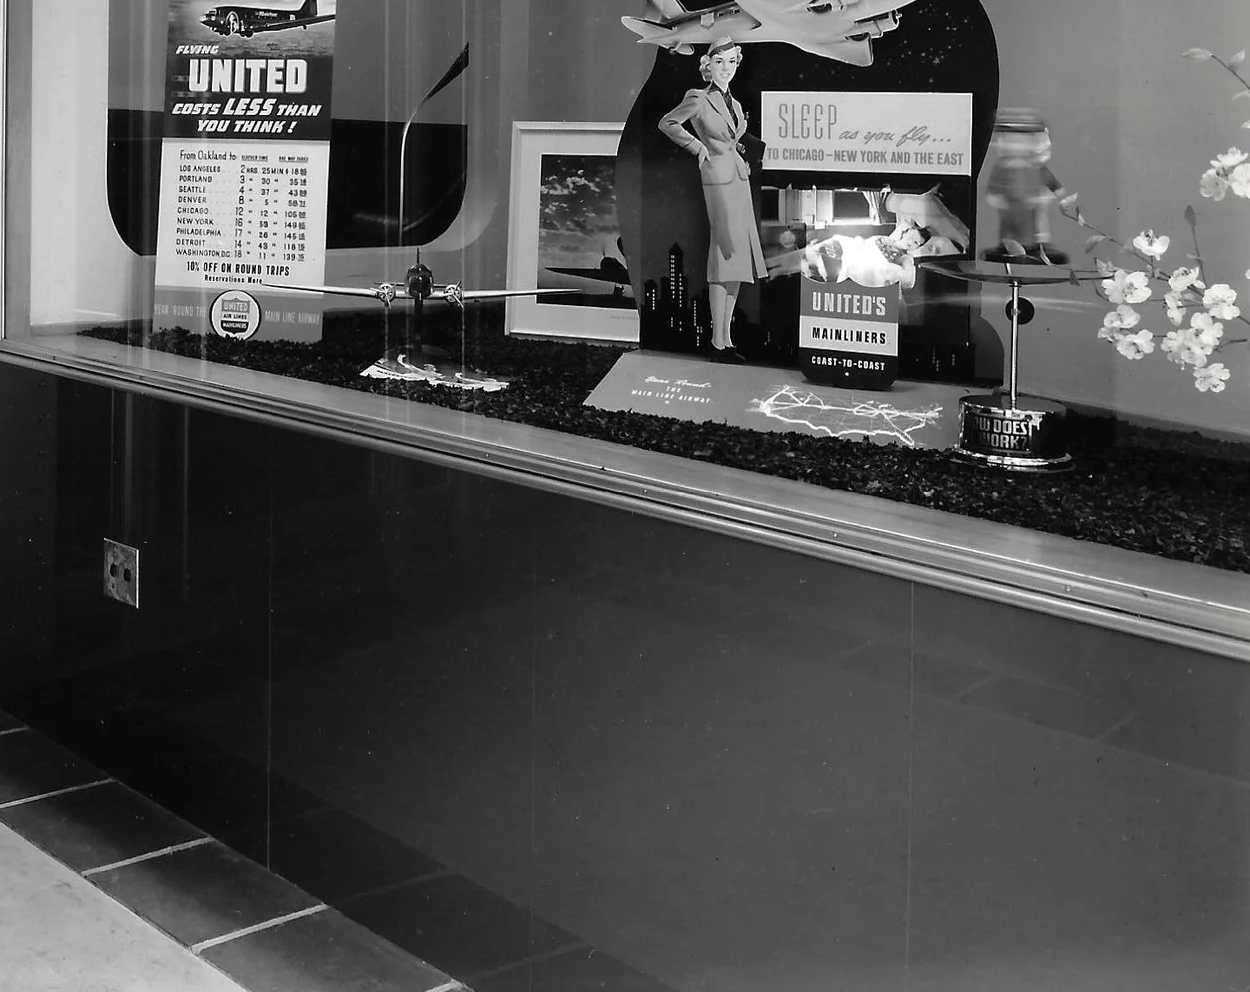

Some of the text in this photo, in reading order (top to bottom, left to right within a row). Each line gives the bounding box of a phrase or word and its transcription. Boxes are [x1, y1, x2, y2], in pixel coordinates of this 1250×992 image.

[175, 44, 220, 55] FLYING
[188, 58, 308, 94] UNITED
[171, 97, 322, 117] COSTS LESS THAN
[197, 119, 231, 132] YOU
[778, 103, 837, 140] SLEEP
[838, 128, 859, 140] as
[864, 129, 895, 145] you
[179, 149, 237, 161] From Oakland to
[767, 148, 779, 160] TO
[860, 150, 887, 164] YORK
[890, 151, 911, 165] AND
[913, 152, 934, 165] THE
[937, 152, 964, 166] EAST
[193, 165, 221, 173] ANGELES
[240, 164, 246, 174] 2
[179, 175, 212, 183] PORTLAND
[240, 175, 245, 184] 3
[239, 186, 244, 194] 4
[238, 196, 244, 205] 8
[177, 207, 209, 215] CHICAGO
[235, 207, 244, 216] 12
[176, 217, 193, 225] NEW
[235, 218, 243, 227] 16
[176, 228, 221, 236] PHILADELPHIA
[234, 228, 243, 237] 17
[176, 238, 206, 246] DETROIT
[234, 239, 242, 248] 14
[234, 250, 242, 258] 18
[186, 261, 290, 276] 10% OFF ON ROUND TRIPS
[204, 274, 263, 285] Reservations Here
[223, 302, 248, 312] UNITED
[812, 291, 886, 316] UNITED'S
[264, 310, 321, 325] MAIN LINE AIRWAY
[812, 327, 886, 344] MAINLINERS
[811, 356, 885, 371] COAST-TO-COAST
[993, 418, 1028, 436] DOES
